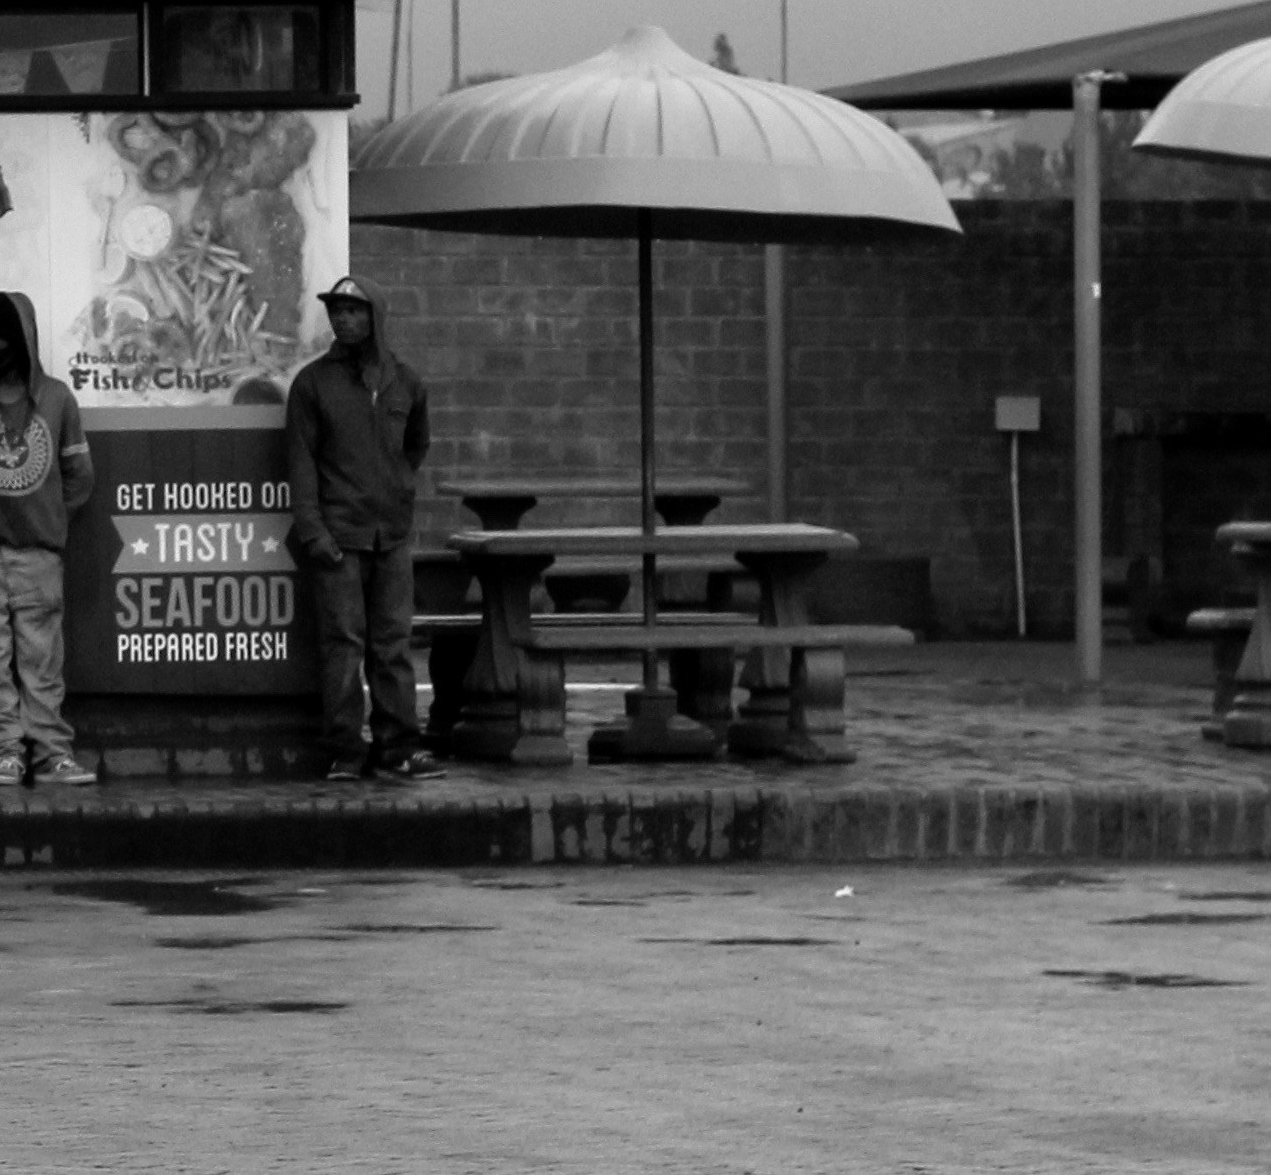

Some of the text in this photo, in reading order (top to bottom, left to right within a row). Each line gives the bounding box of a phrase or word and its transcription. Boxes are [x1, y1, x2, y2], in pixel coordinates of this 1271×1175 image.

[69, 368, 130, 391] Fish
[153, 367, 232, 394] Chips
[116, 481, 291, 511] GET HOOKED ON
[154, 522, 255, 563] TASTY
[115, 575, 293, 629] SEAFOOD
[117, 631, 287, 663] PREPARED FRESH
